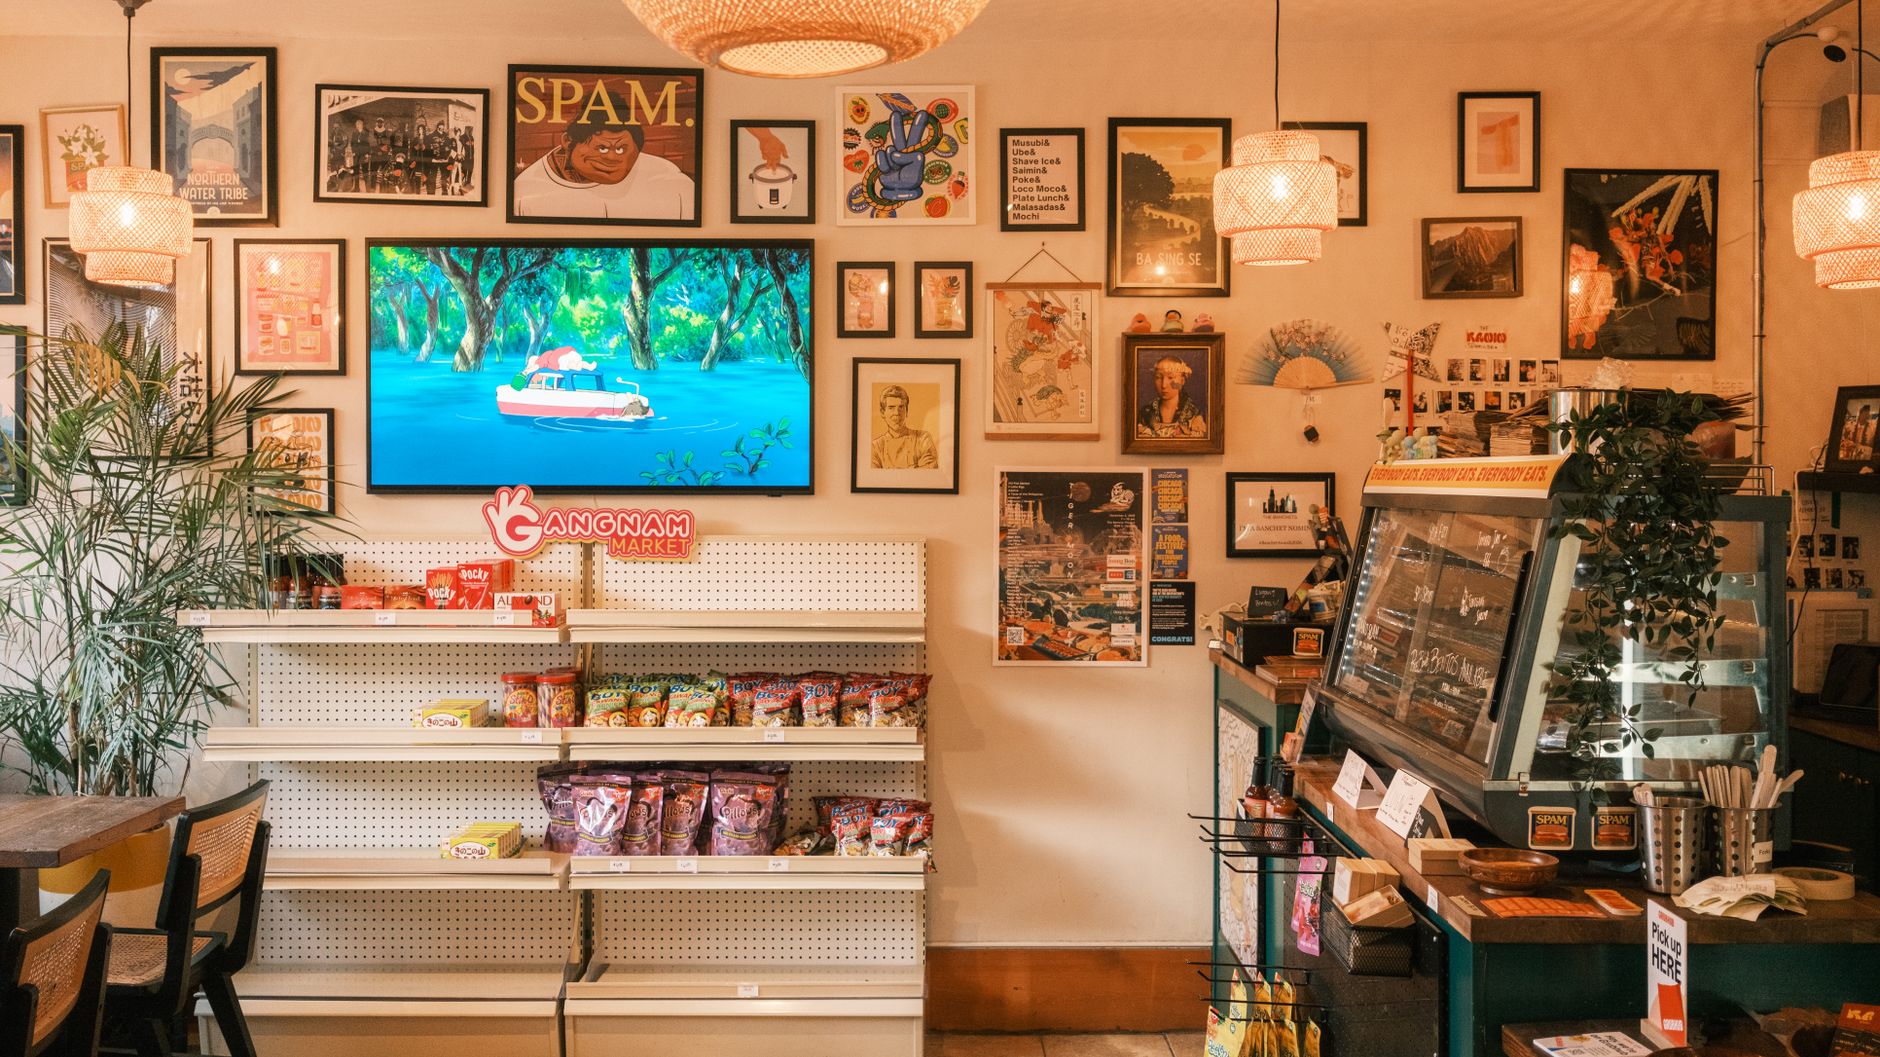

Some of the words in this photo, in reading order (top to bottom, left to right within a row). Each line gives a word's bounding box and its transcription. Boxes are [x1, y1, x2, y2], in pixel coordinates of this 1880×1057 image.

[516, 77, 695, 128] SPAM.
[1012, 139, 1050, 147] Musubi&
[1012, 148, 1036, 156] Ube&
[1012, 157, 1039, 165] Shave
[1041, 157, 1061, 165] Ice&
[1012, 166, 1048, 174] Saimin&
[187, 171, 241, 186] NORTHERN
[1012, 175, 1041, 183] Poke&
[179, 187, 216, 200] WATER
[219, 187, 249, 200] TRIBE
[1012, 185, 1034, 193] Loco
[1035, 185, 1067, 193] Moco&
[1012, 194, 1035, 202] Plate
[1037, 194, 1070, 202] Lunch&
[1012, 203, 1066, 211] Malasadas&
[1012, 212, 1040, 220] Mochi
[1136, 252, 1153, 266] BA
[1158, 252, 1184, 266] SING
[1188, 252, 1202, 266] SE
[1371, 468, 1402, 481] EVERYBODY
[1401, 468, 1420, 481] EATS.
[1419, 467, 1456, 481] EVERYBODY
[1456, 467, 1477, 482] EATS.
[1476, 466, 1525, 482] EVERYBODY
[1522, 465, 1548, 482] EATS.
[484, 486, 691, 553] GANGNAM
[611, 538, 690, 554] MARKET
[1066, 542, 1075, 579] MOON
[802, 683, 835, 699] BOY
[426, 718, 459, 727] きのこの山
[723, 807, 758, 819] Pillows
[1535, 814, 1567, 825] SPAM
[1599, 814, 1629, 825] SPAM
[455, 846, 486, 857] きのこの山
[1652, 921, 1670, 948] Pick
[1670, 936, 1682, 960] up
[1651, 943, 1682, 985] HERE
